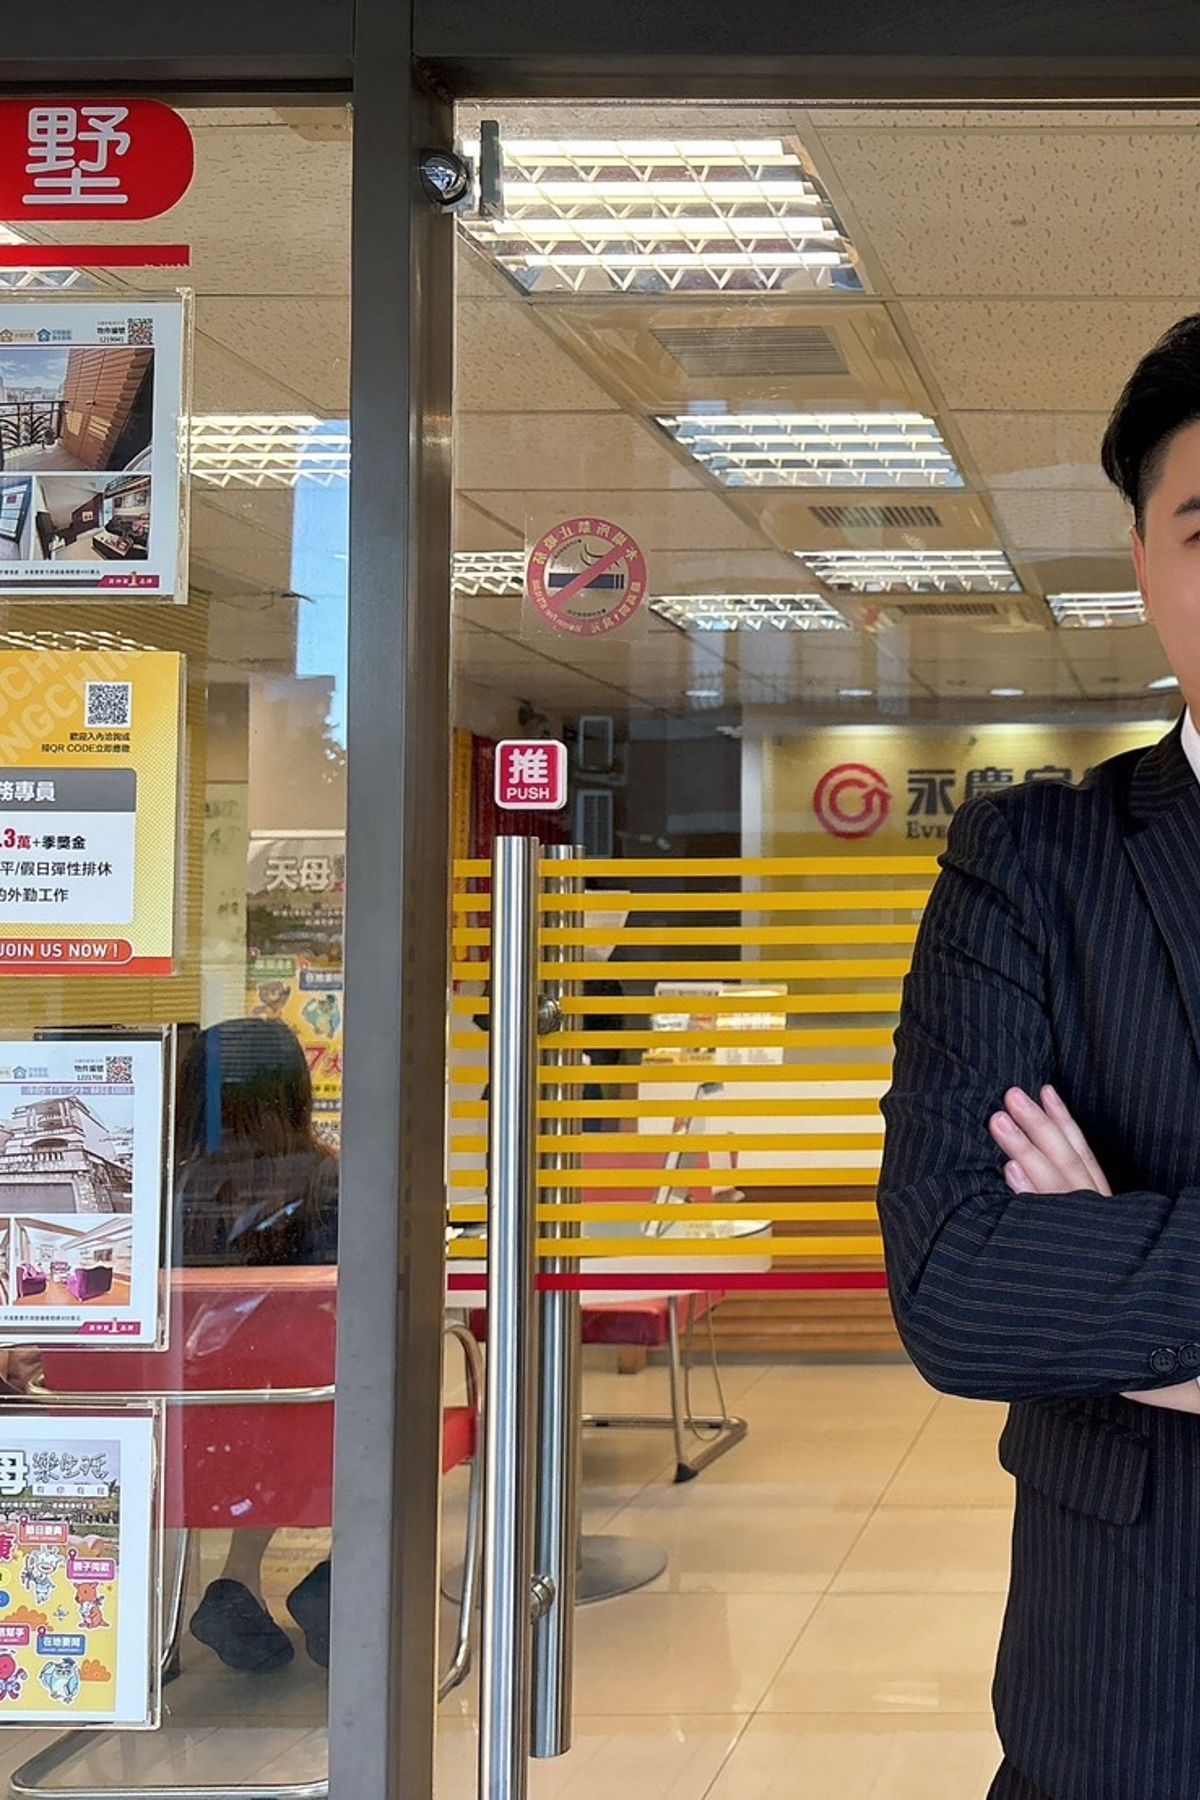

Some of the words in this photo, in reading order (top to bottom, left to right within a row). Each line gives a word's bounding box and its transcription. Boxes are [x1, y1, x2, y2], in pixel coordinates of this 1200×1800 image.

[21, 106, 131, 204] 墅
[508, 748, 549, 784] 推
[506, 787, 550, 800] PUSH
[265, 856, 331, 893] 天母
[41, 943, 62, 957] US
[69, 943, 108, 957] NOW
